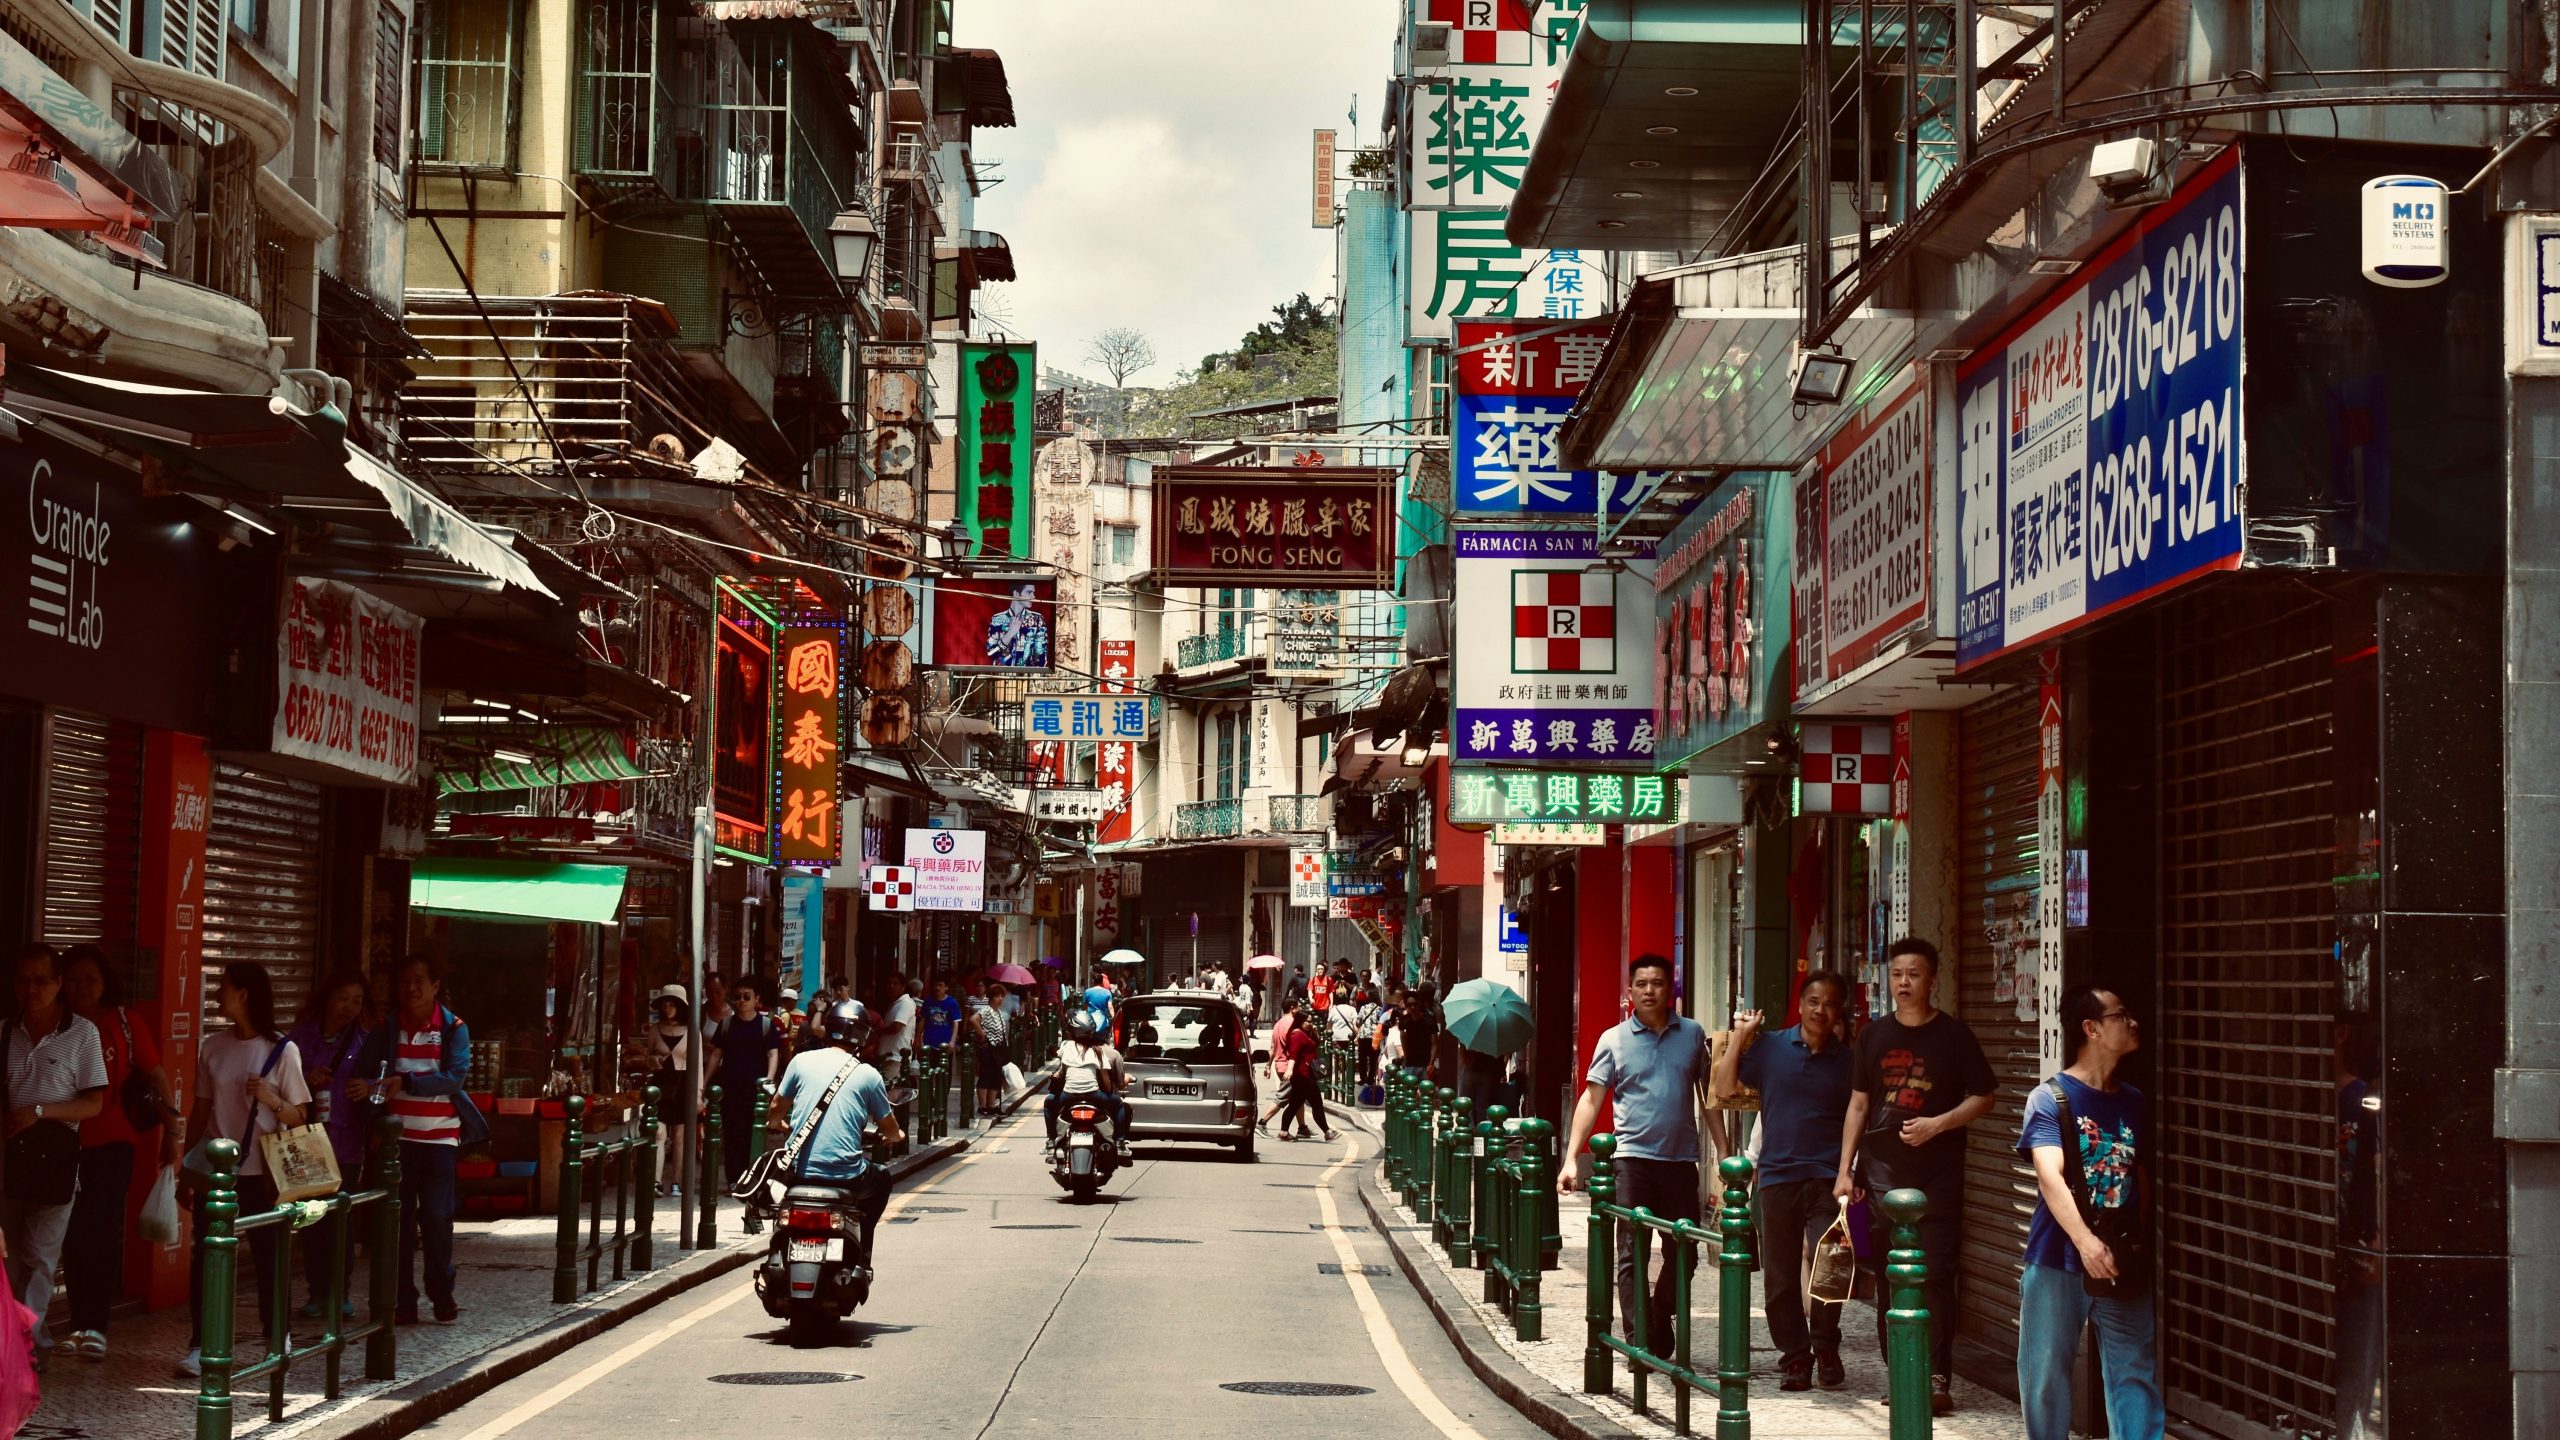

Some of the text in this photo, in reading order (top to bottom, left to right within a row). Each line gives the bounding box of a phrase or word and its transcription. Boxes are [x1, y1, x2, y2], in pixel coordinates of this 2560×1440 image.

[1424, 77, 1530, 320] 藥房
[2393, 231, 2434, 239] SYSTEMS
[2091, 204, 2235, 422] 2876-8218
[1852, 402, 1921, 508] 6533-8104
[1961, 376, 1999, 595] 租
[2091, 386, 2232, 581] 6268-1521
[30, 459, 110, 566] Grande
[1546, 537, 1575, 551] SAN
[1852, 469, 1921, 579] 6538-2043
[2011, 468, 2082, 590] 獨家代理
[1211, 545, 1342, 566] FONG SENG
[1852, 538, 1921, 632] 6617-0885
[67, 558, 103, 650] Lab
[1961, 602, 1976, 636] FOR
[1979, 588, 2000, 626] RENT
[1275, 652, 1297, 662] MAN
[1299, 652, 1313, 662] OU
[284, 681, 326, 744] 6683
[1031, 699, 1144, 737] 電訊通
[1499, 684, 1628, 700] 政府註冊藥劑師
[359, 705, 390, 763] 6695
[783, 640, 836, 848] 國泰行
[1468, 718, 1655, 755] 新萬興藥房
[1459, 775, 1664, 817] 新萬興藥房
[1095, 867, 1119, 933] 富安
[1331, 899, 1347, 910] 24
[1153, 1084, 1198, 1095] MK-61-10
